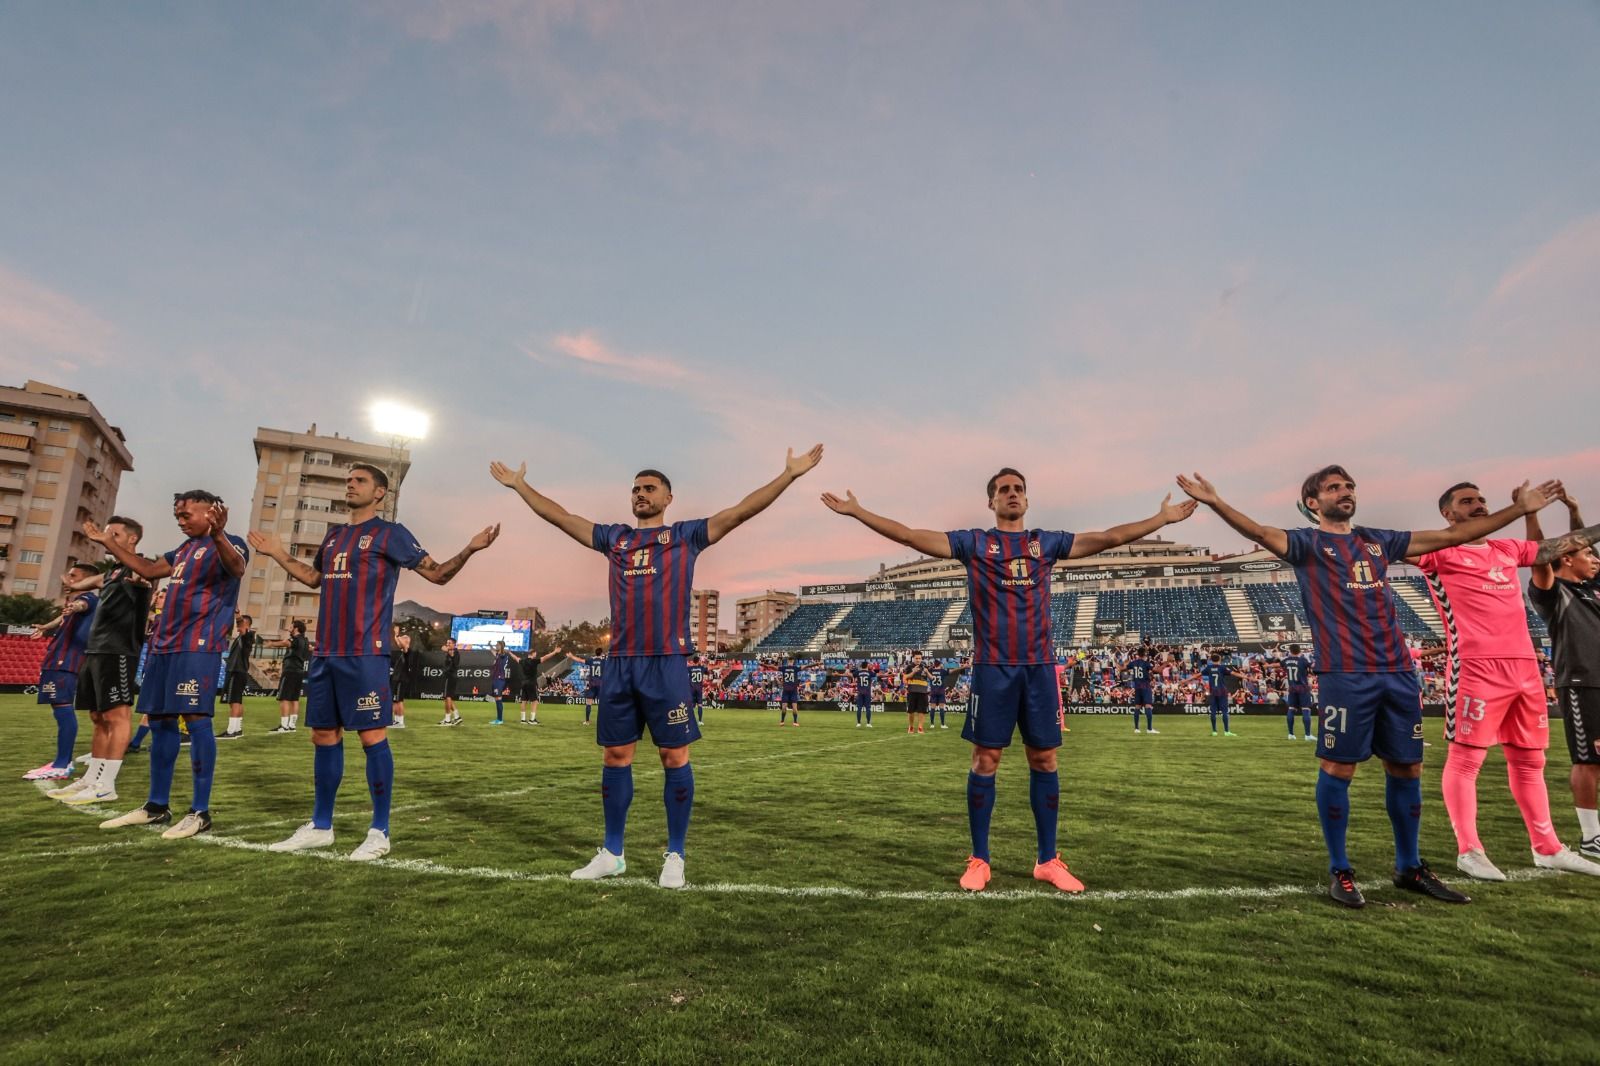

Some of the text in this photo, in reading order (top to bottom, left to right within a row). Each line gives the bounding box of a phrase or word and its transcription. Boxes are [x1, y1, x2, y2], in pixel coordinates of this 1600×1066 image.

[624, 566, 657, 576] network
[1066, 571, 1113, 581] finetwork
[1002, 578, 1034, 586] network
[1346, 580, 1384, 589] network
[691, 672, 702, 682] 20
[1133, 666, 1144, 678] 16
[1287, 666, 1298, 680] 17
[784, 673, 795, 682] 24
[860, 676, 869, 687] 15
[1212, 673, 1219, 687] 7
[177, 682, 199, 692] CRC
[358, 695, 380, 706] CRC
[1462, 696, 1486, 721] 13
[1324, 705, 1348, 733] 21
